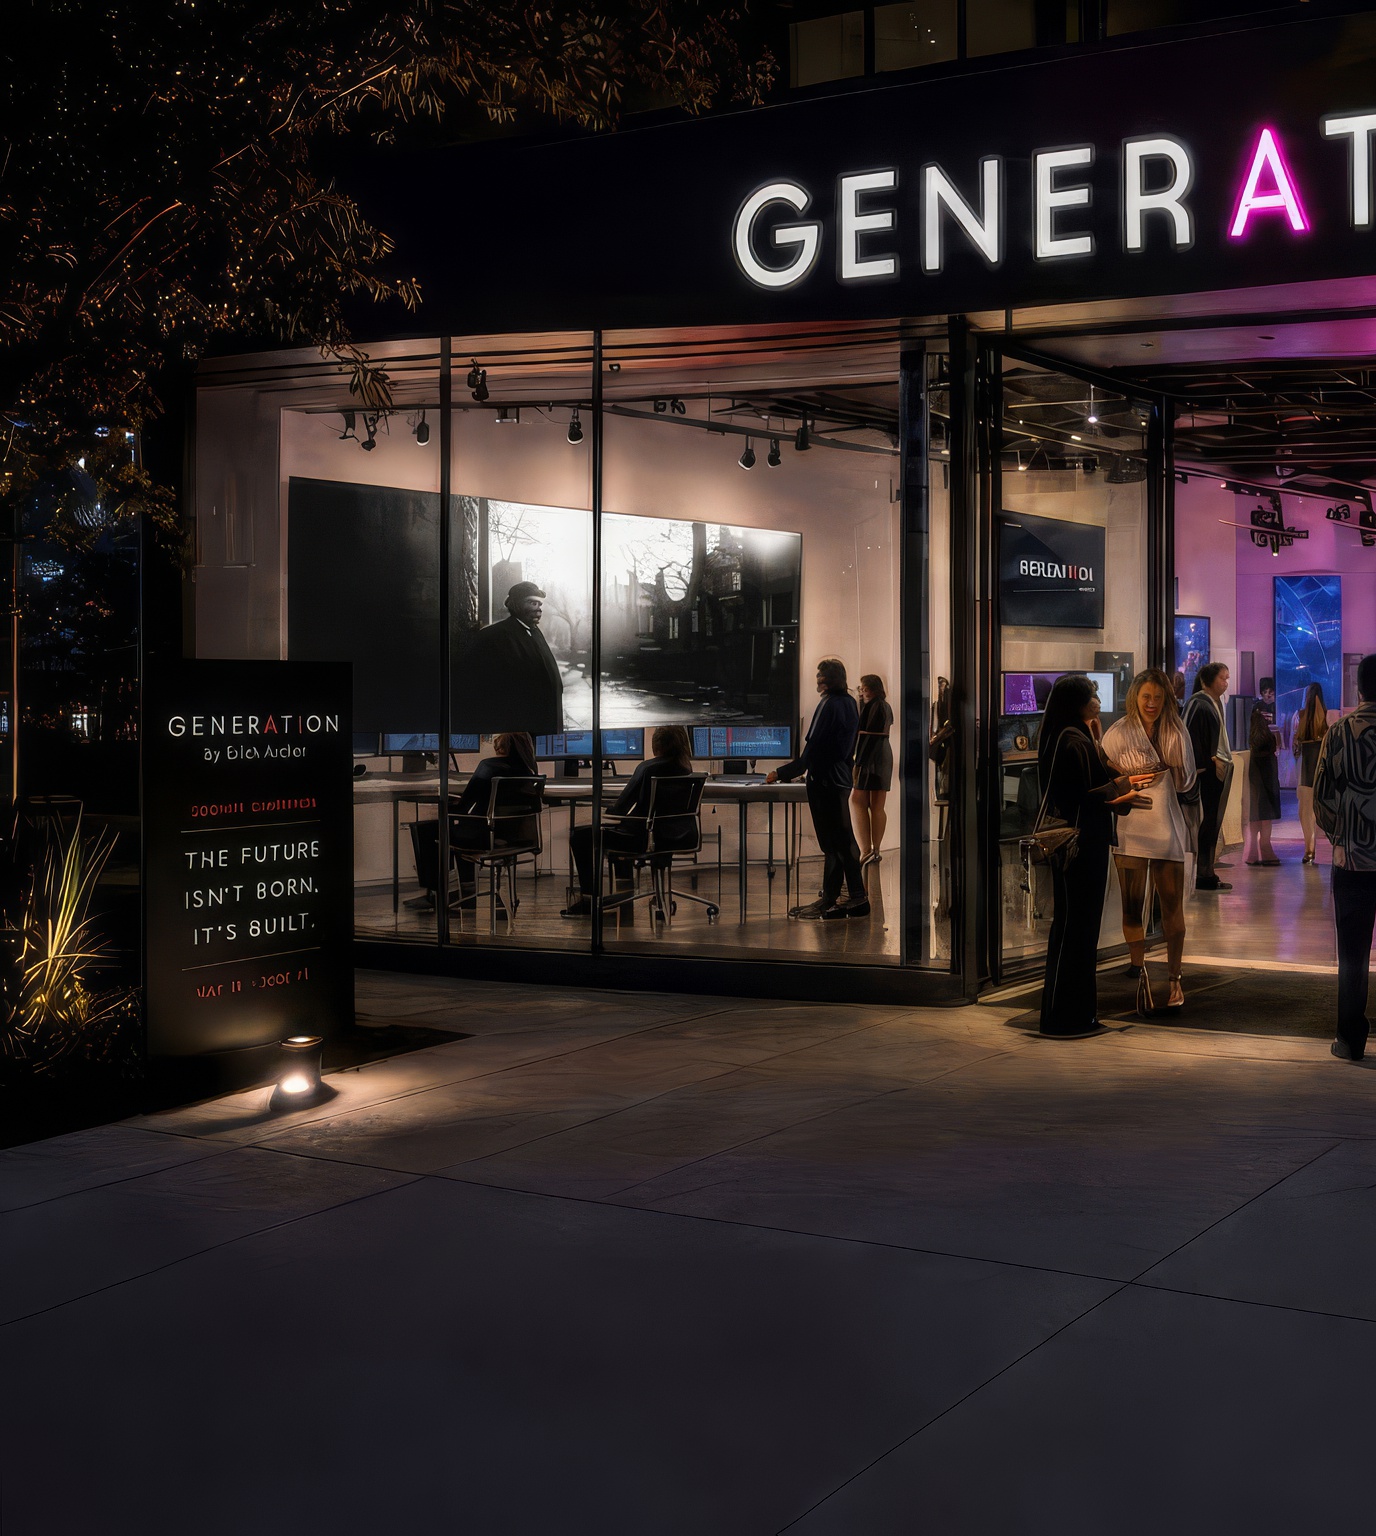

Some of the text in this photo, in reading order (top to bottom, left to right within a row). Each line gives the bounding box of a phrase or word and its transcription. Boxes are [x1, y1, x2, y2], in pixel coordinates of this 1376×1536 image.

[168, 713, 339, 738] GENERATION
[184, 840, 320, 869] THE FUTURE
[185, 876, 319, 909] ISN'T BORN.
[194, 923, 237, 945] IT'S
